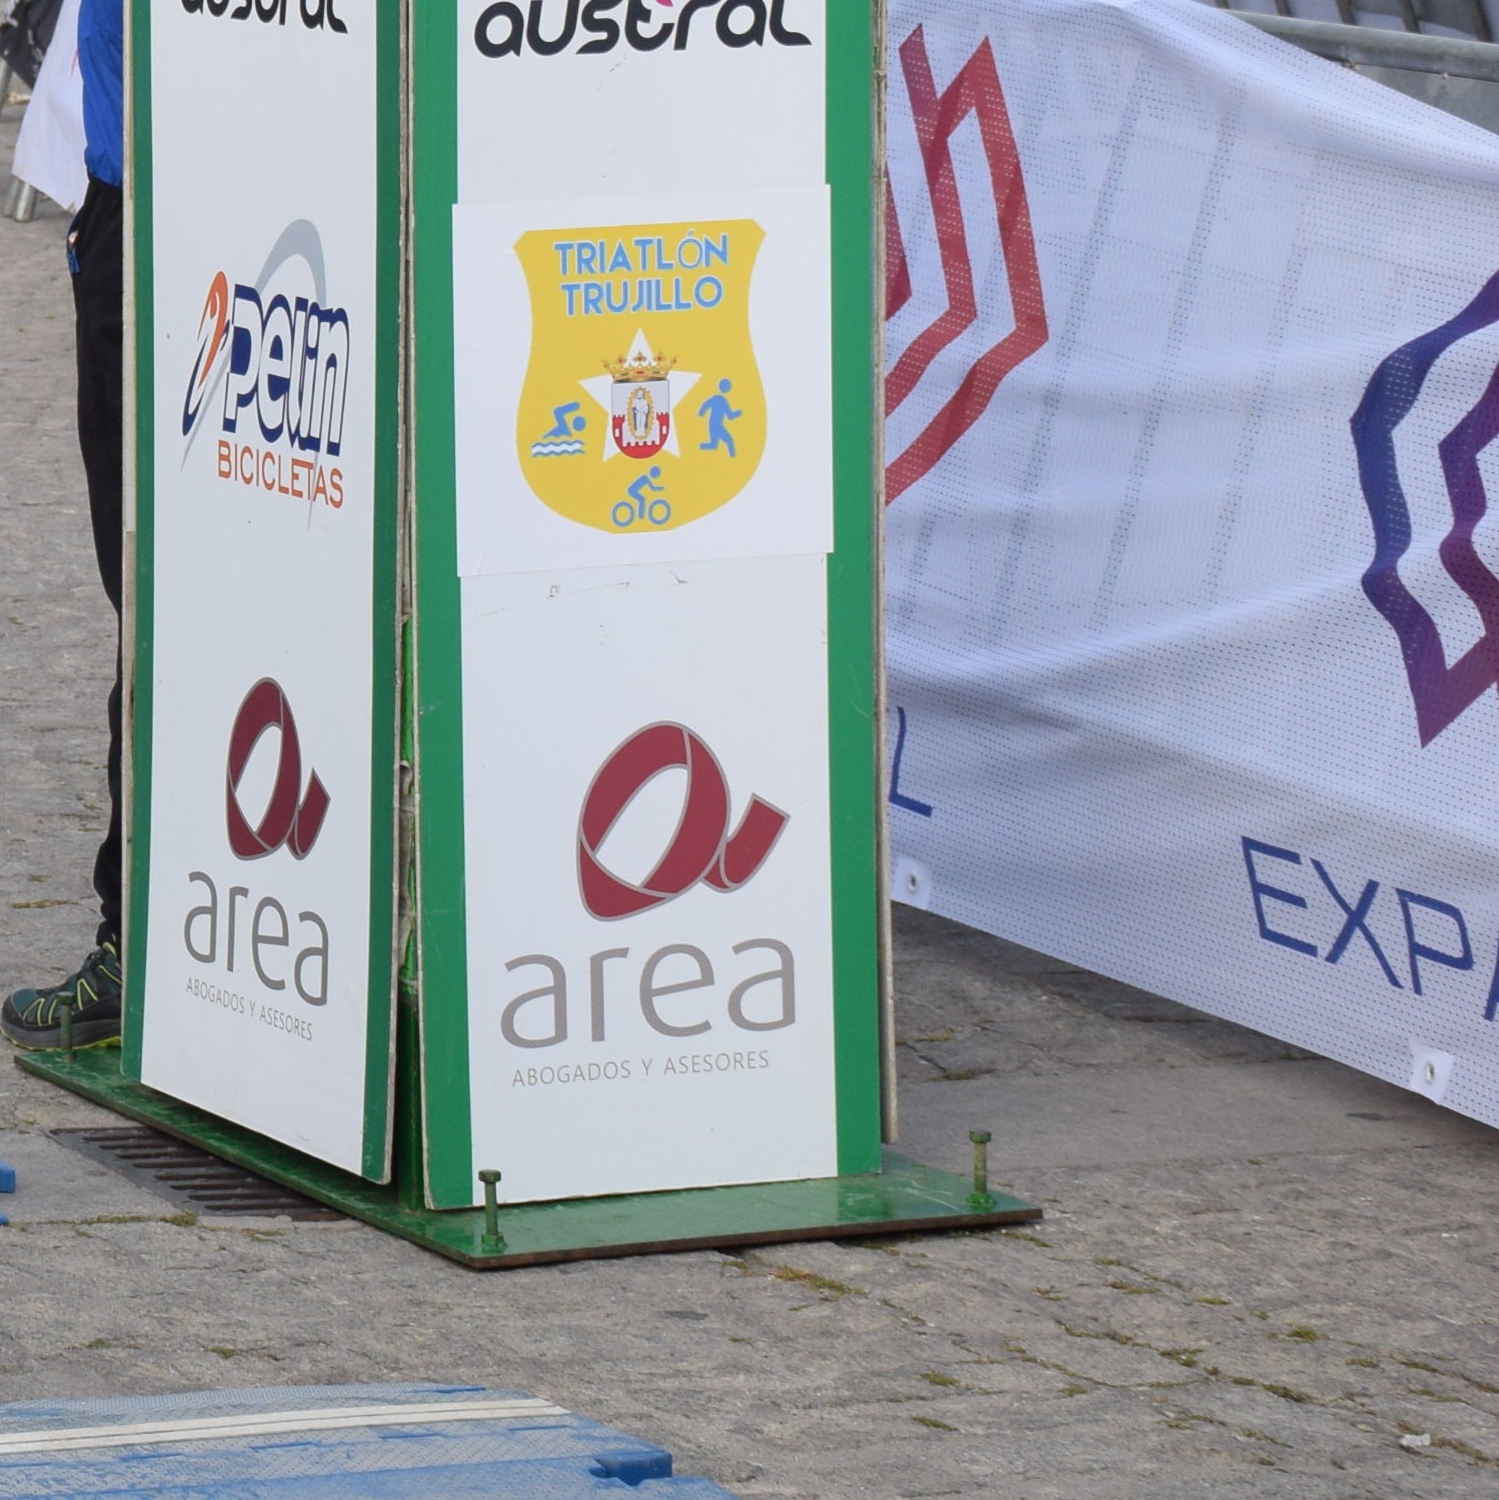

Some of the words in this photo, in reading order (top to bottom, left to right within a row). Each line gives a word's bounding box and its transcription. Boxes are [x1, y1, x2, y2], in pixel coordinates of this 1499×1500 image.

[553, 228, 730, 276] TRIATLÓN
[560, 275, 724, 317] TRUJILLO
[217, 438, 345, 510] BICICLETAS
[183, 870, 330, 1007] area
[185, 976, 246, 1016] ABOGADOS
[248, 1001, 255, 1018] Y
[259, 1006, 314, 1042] ASESORES
[499, 936, 797, 1050] area
[511, 1059, 632, 1088] ABOGADOS
[641, 1059, 653, 1077] Y
[663, 1050, 770, 1076] ASESORES
